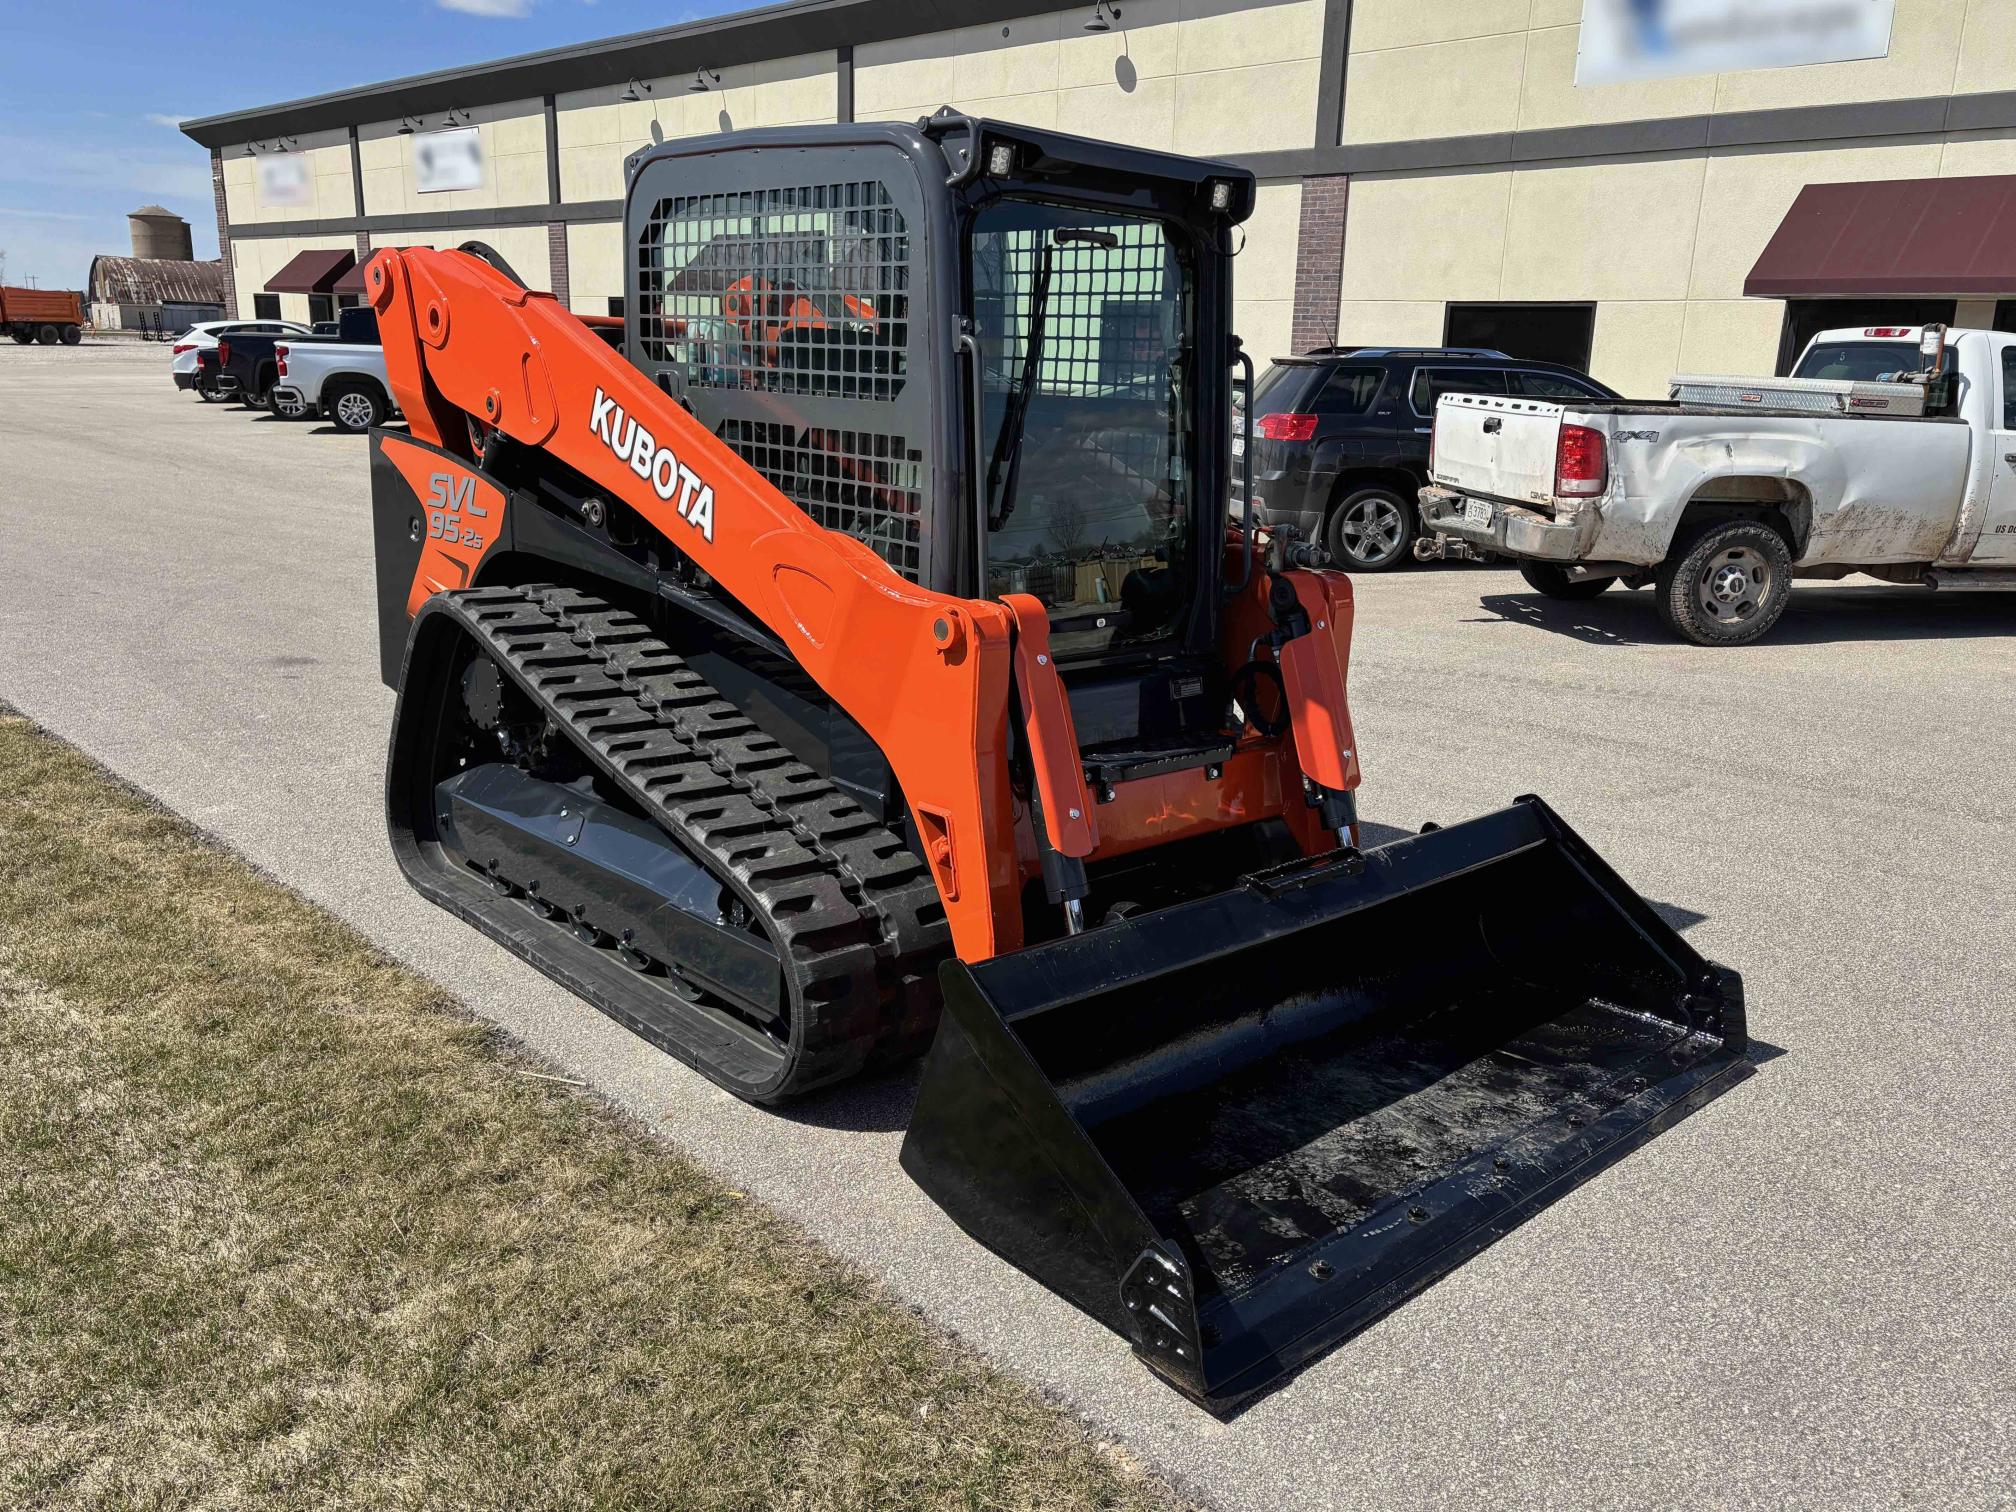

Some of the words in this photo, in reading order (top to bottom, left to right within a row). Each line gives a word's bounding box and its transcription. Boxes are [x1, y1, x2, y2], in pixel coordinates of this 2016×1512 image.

[589, 385, 715, 544] KUBOTA
[427, 472, 488, 518] SVL
[1530, 490, 1549, 502] GMC
[1995, 524, 2007, 534] US
